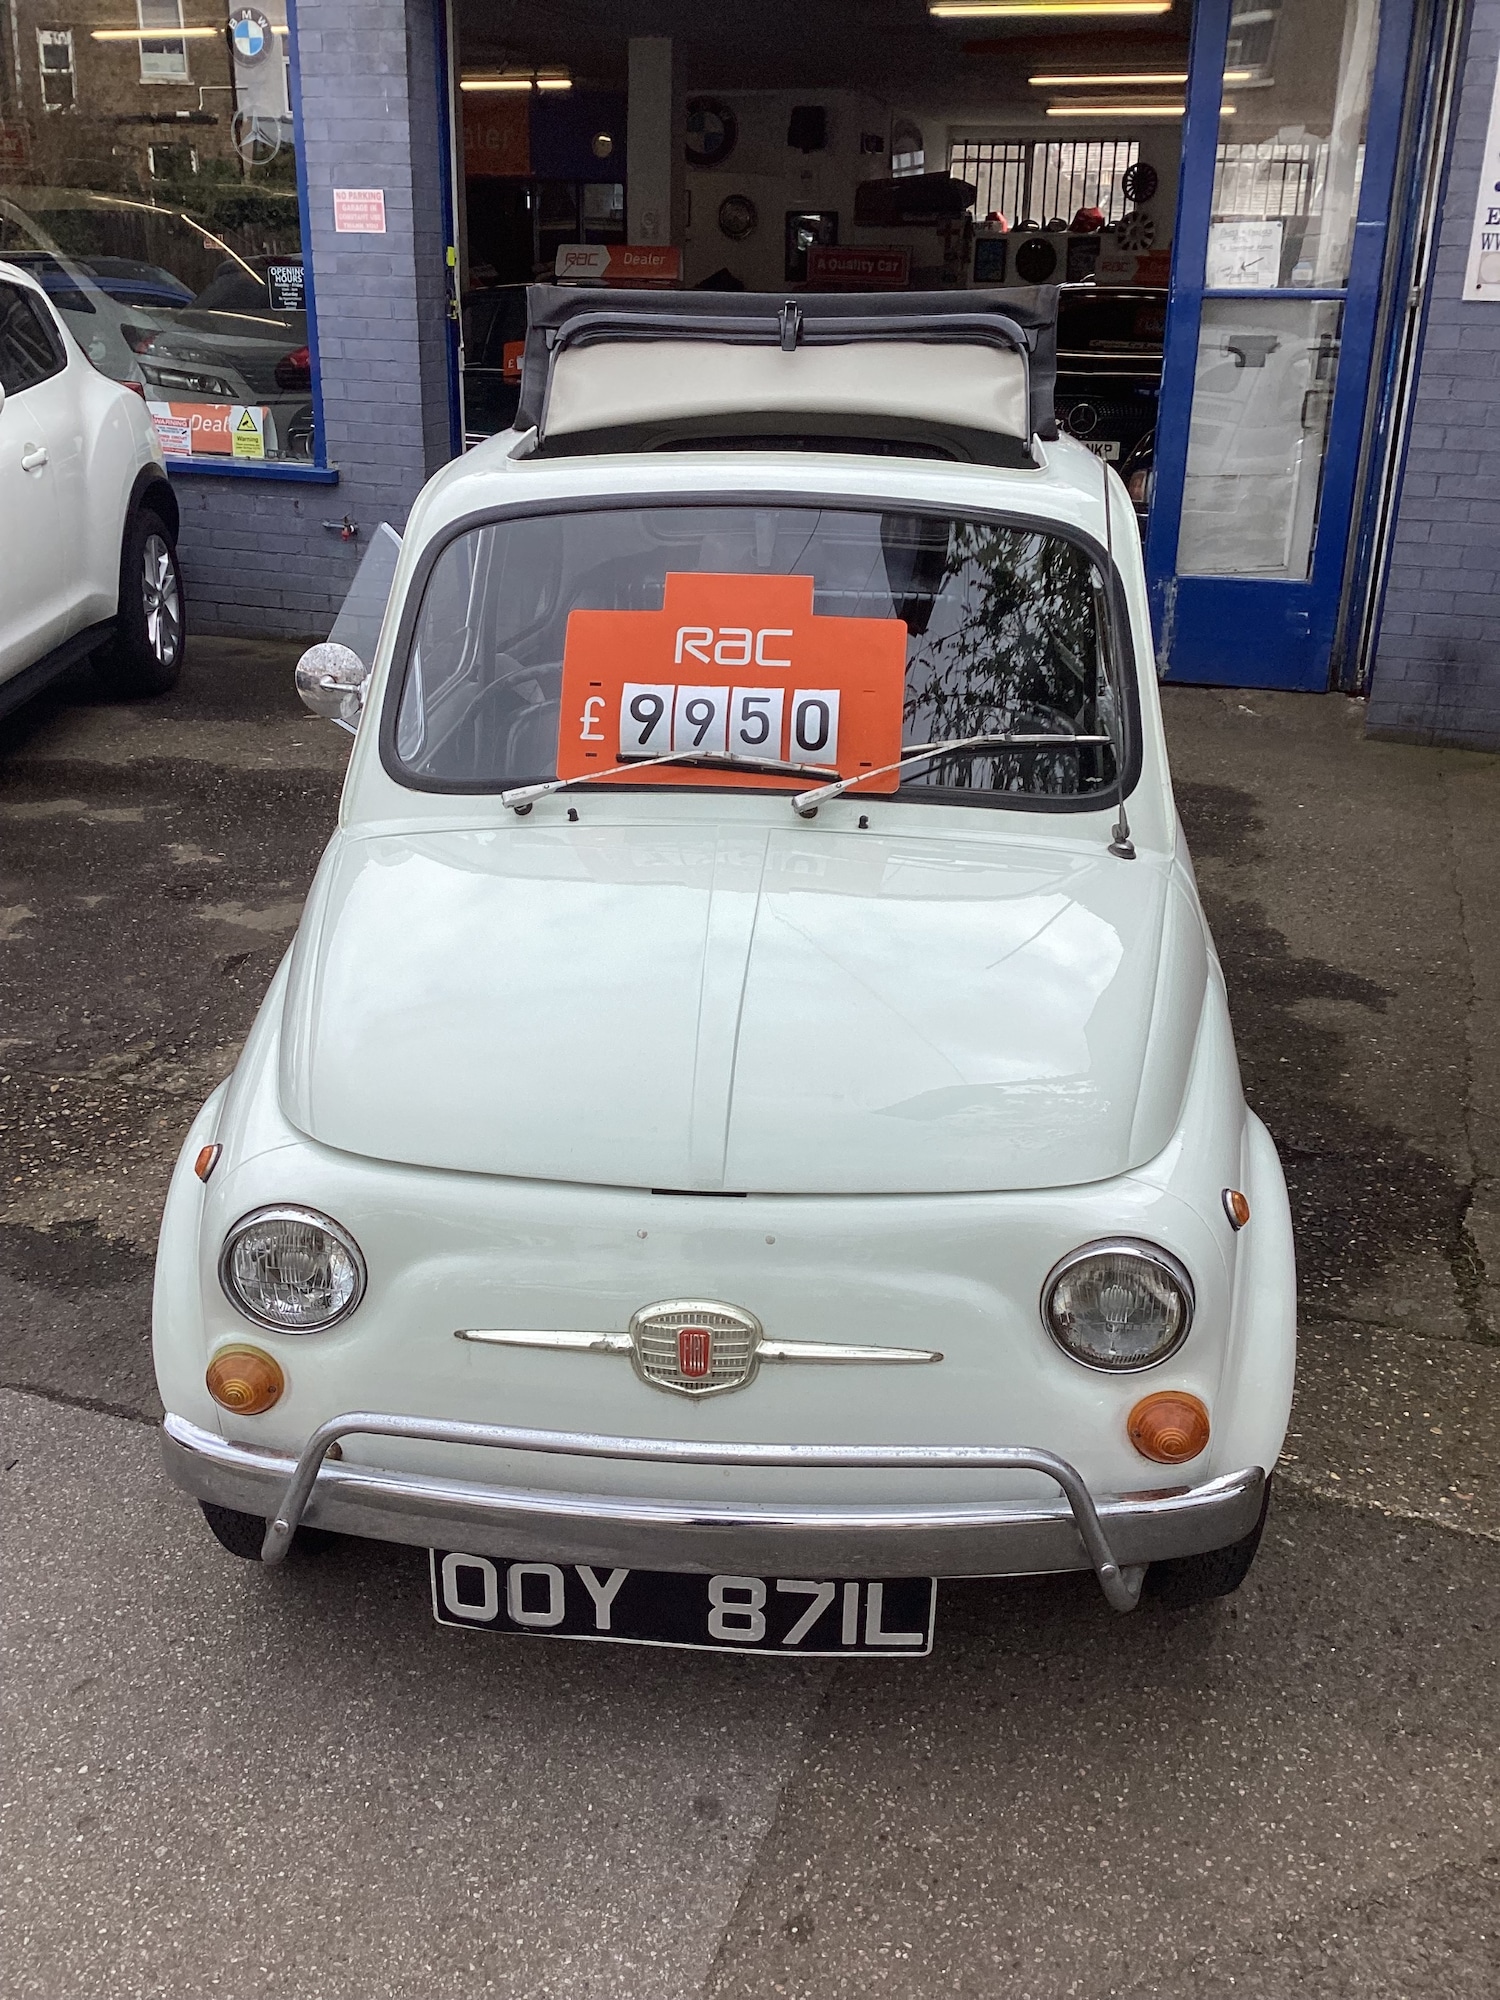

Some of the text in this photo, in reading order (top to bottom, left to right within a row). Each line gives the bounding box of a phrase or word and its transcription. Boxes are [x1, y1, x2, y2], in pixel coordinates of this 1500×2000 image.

[228, 9, 268, 30] BMW
[336, 191, 382, 201] NO PARKING
[623, 252, 667, 265] Dealer
[817, 258, 899, 273] A Quality Car
[275, 275, 303, 283] HOURS
[154, 418, 188, 427] WARNING
[236, 435, 259, 443] Warning
[442, 1552, 924, 1646] OOY 871L
